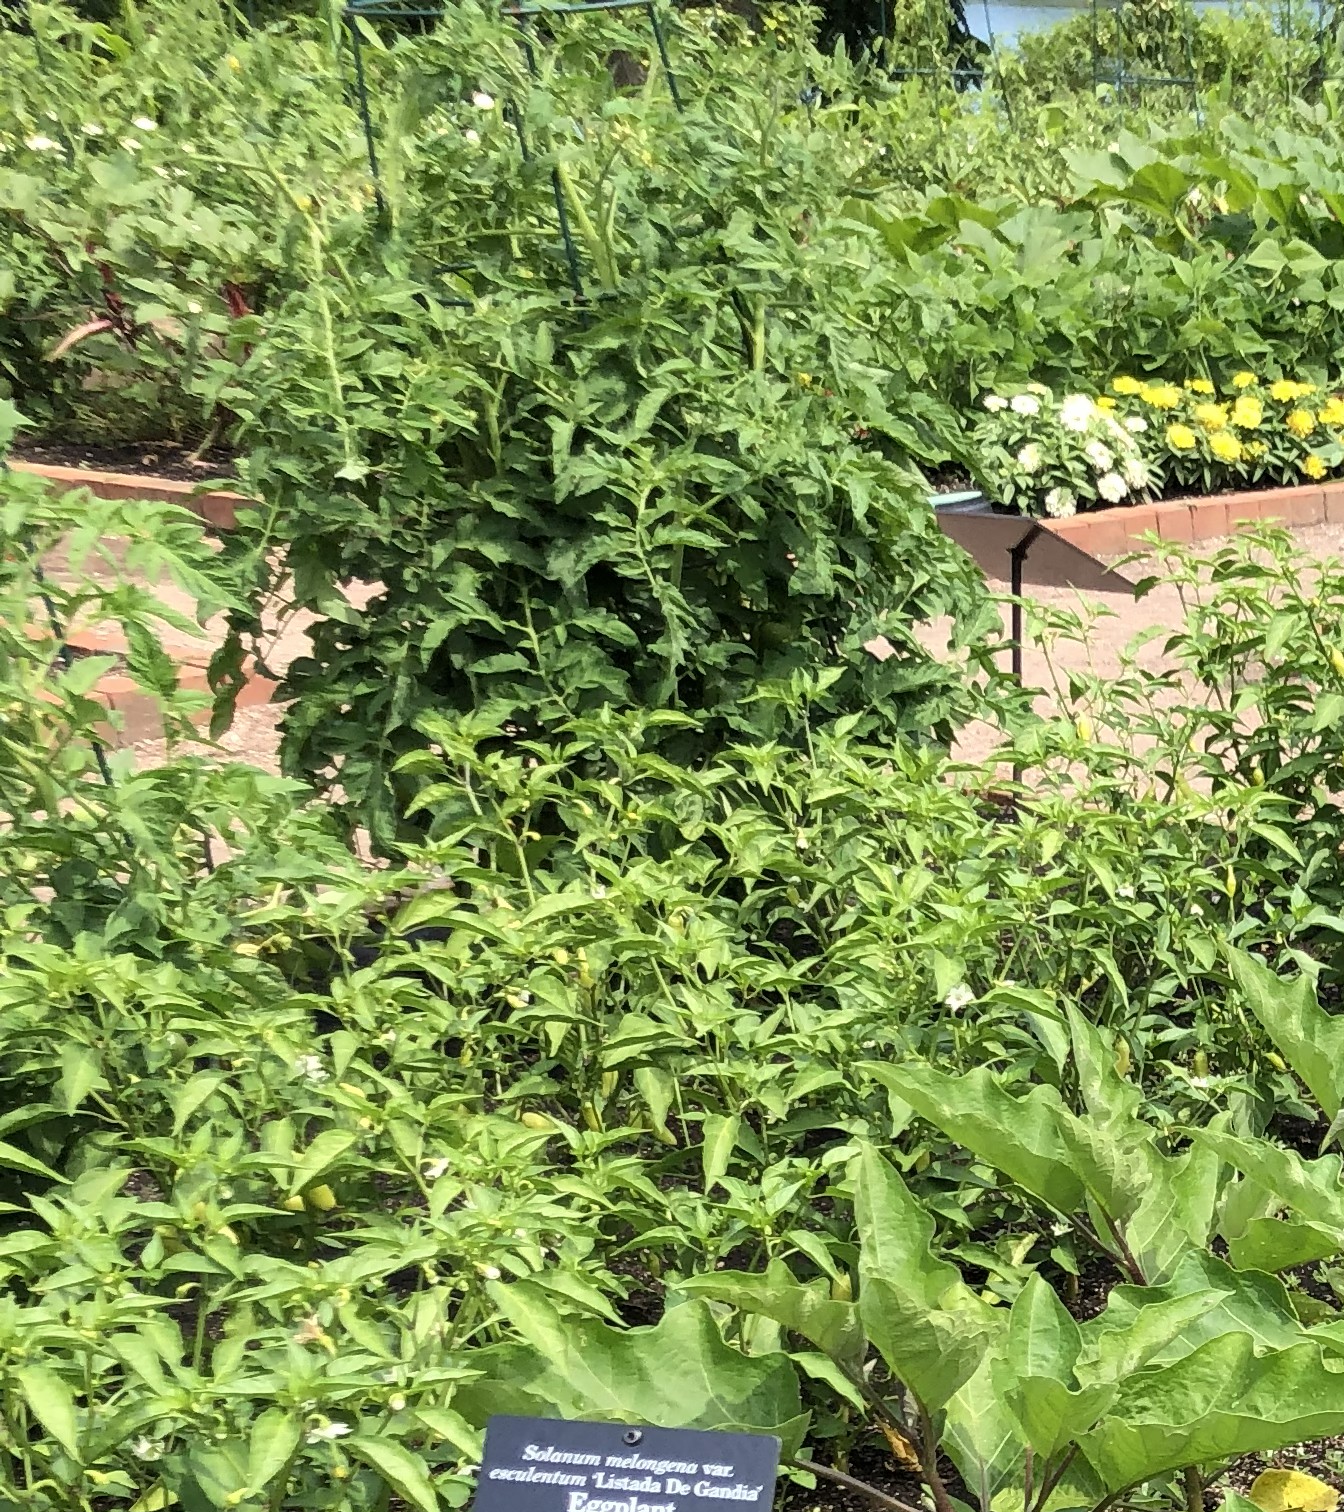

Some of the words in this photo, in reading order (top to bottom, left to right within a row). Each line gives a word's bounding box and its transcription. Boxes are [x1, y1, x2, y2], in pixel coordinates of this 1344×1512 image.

[522, 1444, 600, 1467] Solanum
[605, 1453, 698, 1475] melongena
[703, 1464, 734, 1478] var.
[489, 1467, 586, 1487] esculentum
[666, 1478, 690, 1497] De
